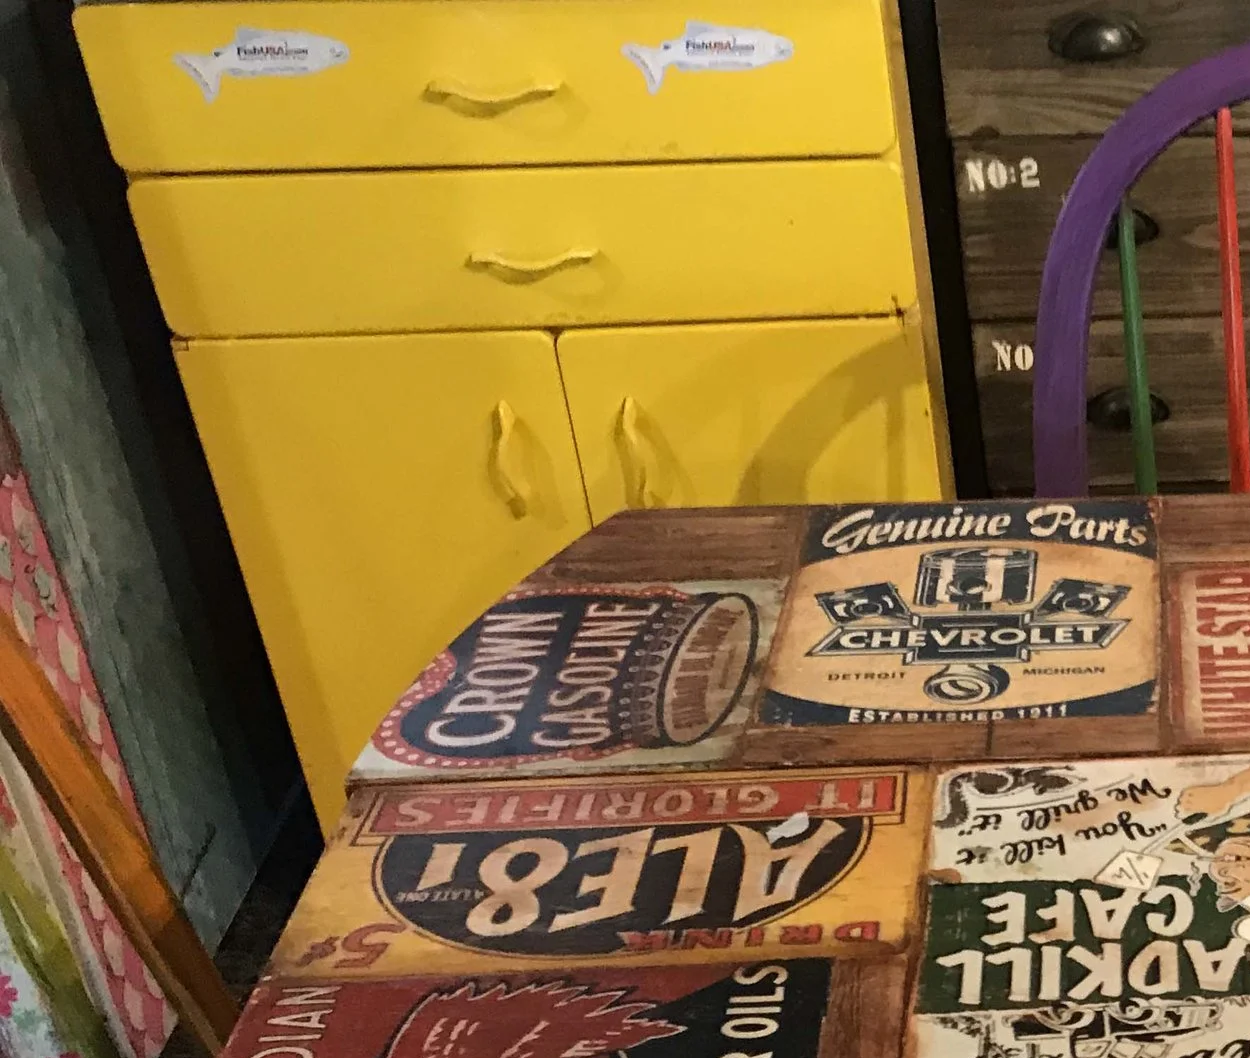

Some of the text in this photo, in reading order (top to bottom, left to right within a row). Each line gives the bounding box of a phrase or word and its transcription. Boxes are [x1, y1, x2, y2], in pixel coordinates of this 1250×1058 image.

[822, 504, 1148, 554] Genuine Parts
[840, 625, 1100, 650] CHEVROLET
[427, 611, 565, 748] CROWN
[532, 600, 661, 747] GASOLINE
[828, 666, 1106, 681] DETROIT MICHIGAN
[848, 707, 1005, 724] ESTABLISHED
[397, 779, 877, 824] IT GLORIFIES
[1018, 789, 1099, 830] grill
[1106, 777, 1172, 805] We
[1001, 832, 1065, 866] kill
[982, 884, 1194, 945] CAFE
[618, 920, 881, 951] DRINK
[722, 964, 789, 1040] OILS
